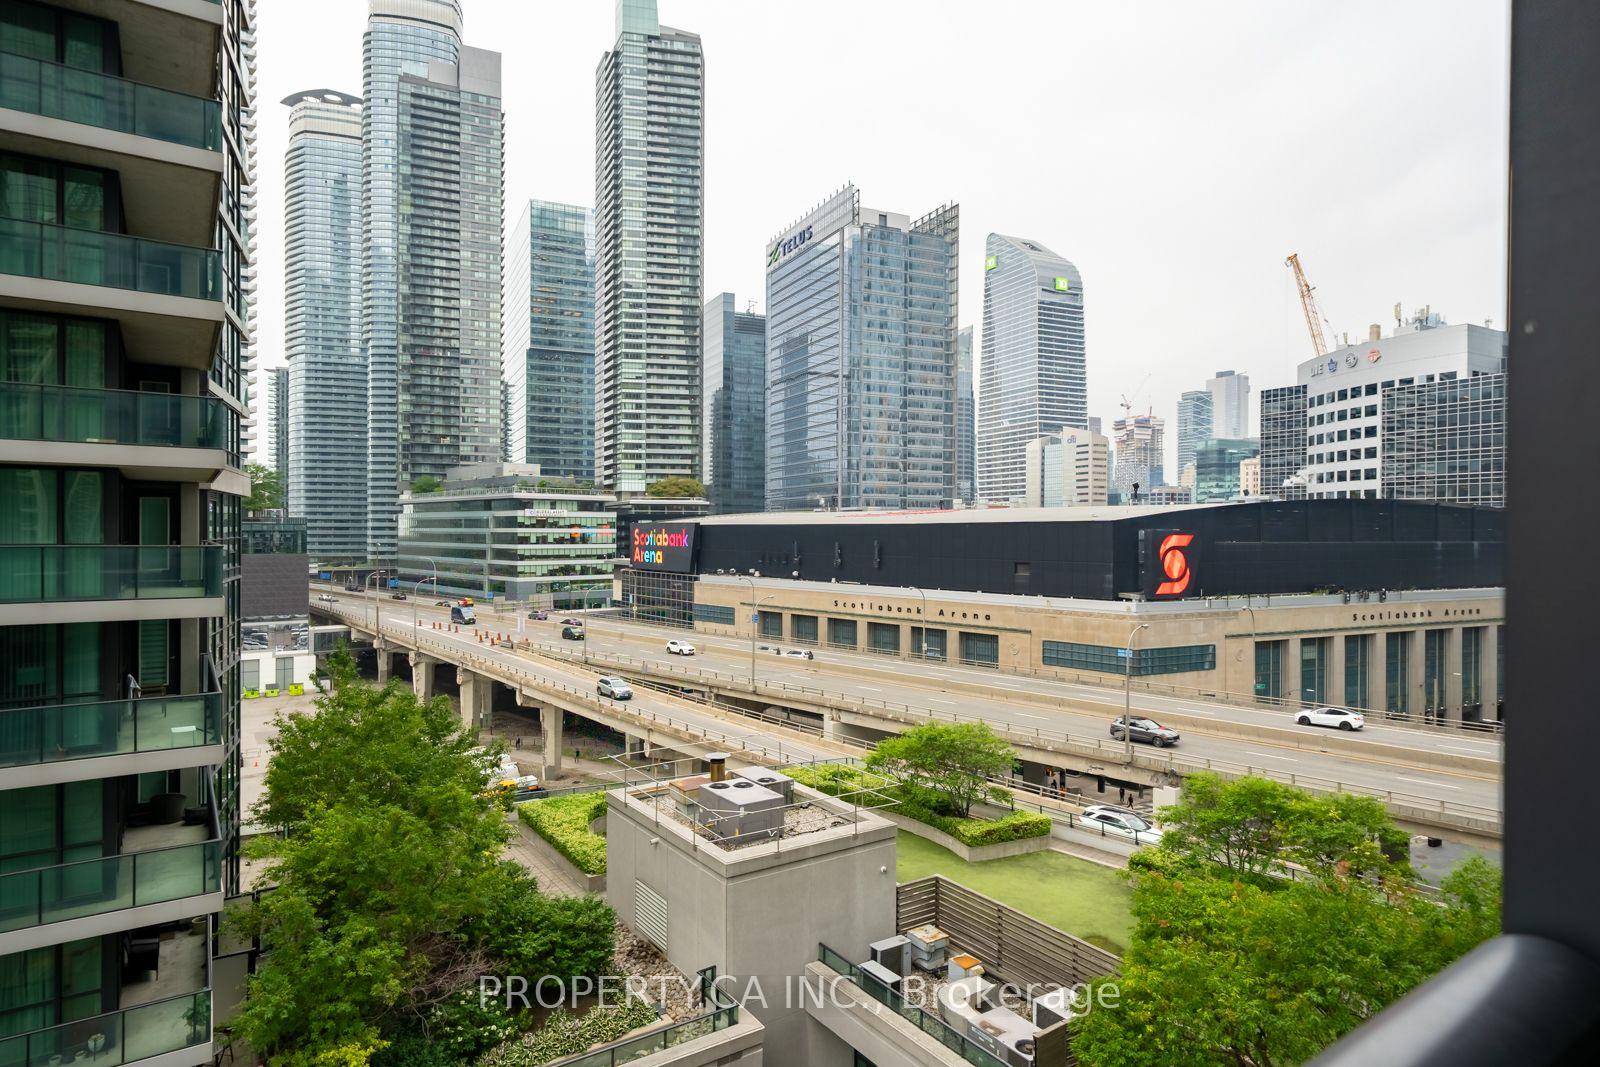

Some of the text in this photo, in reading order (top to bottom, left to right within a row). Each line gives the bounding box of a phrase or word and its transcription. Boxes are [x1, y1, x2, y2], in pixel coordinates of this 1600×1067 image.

[781, 225, 813, 257] TELUS
[633, 528, 689, 547] Scotiabank
[633, 546, 663, 564] Arena
[833, 600, 991, 621] Scotiabank Arena
[1353, 608, 1481, 621] Scotiabank Arena
